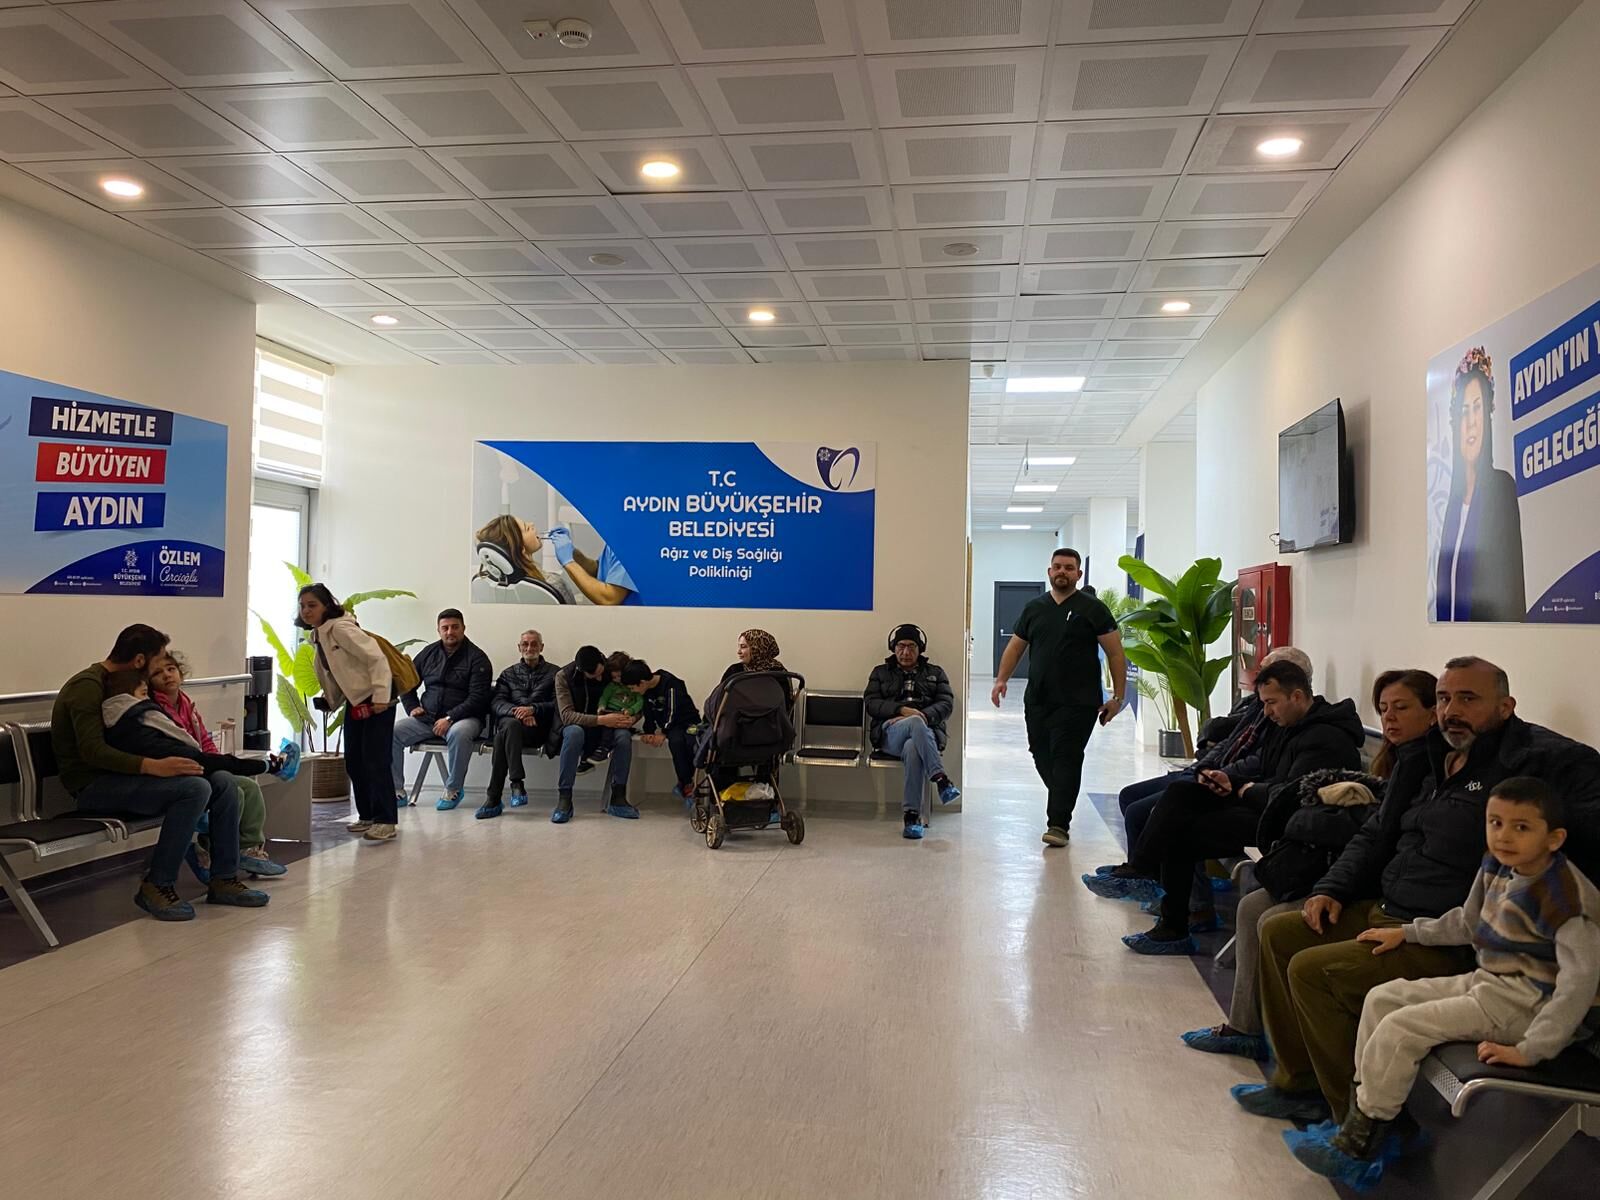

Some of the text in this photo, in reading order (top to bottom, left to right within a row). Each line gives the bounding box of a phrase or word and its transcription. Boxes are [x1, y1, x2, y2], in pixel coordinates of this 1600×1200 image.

[51, 401, 156, 438] HİZMETLE
[56, 445, 151, 478] BÜYÜYEN
[708, 470, 737, 487] T.C
[63, 496, 144, 526] AYDIN
[623, 492, 822, 518] AYDIN BÜYÜKŞEHİR
[669, 519, 775, 538] BELEDİYESİ
[159, 545, 201, 566] ÖZLEM
[660, 546, 783, 563] Ağız ve Diş Sağlığı
[689, 565, 752, 581] Polikliniği
